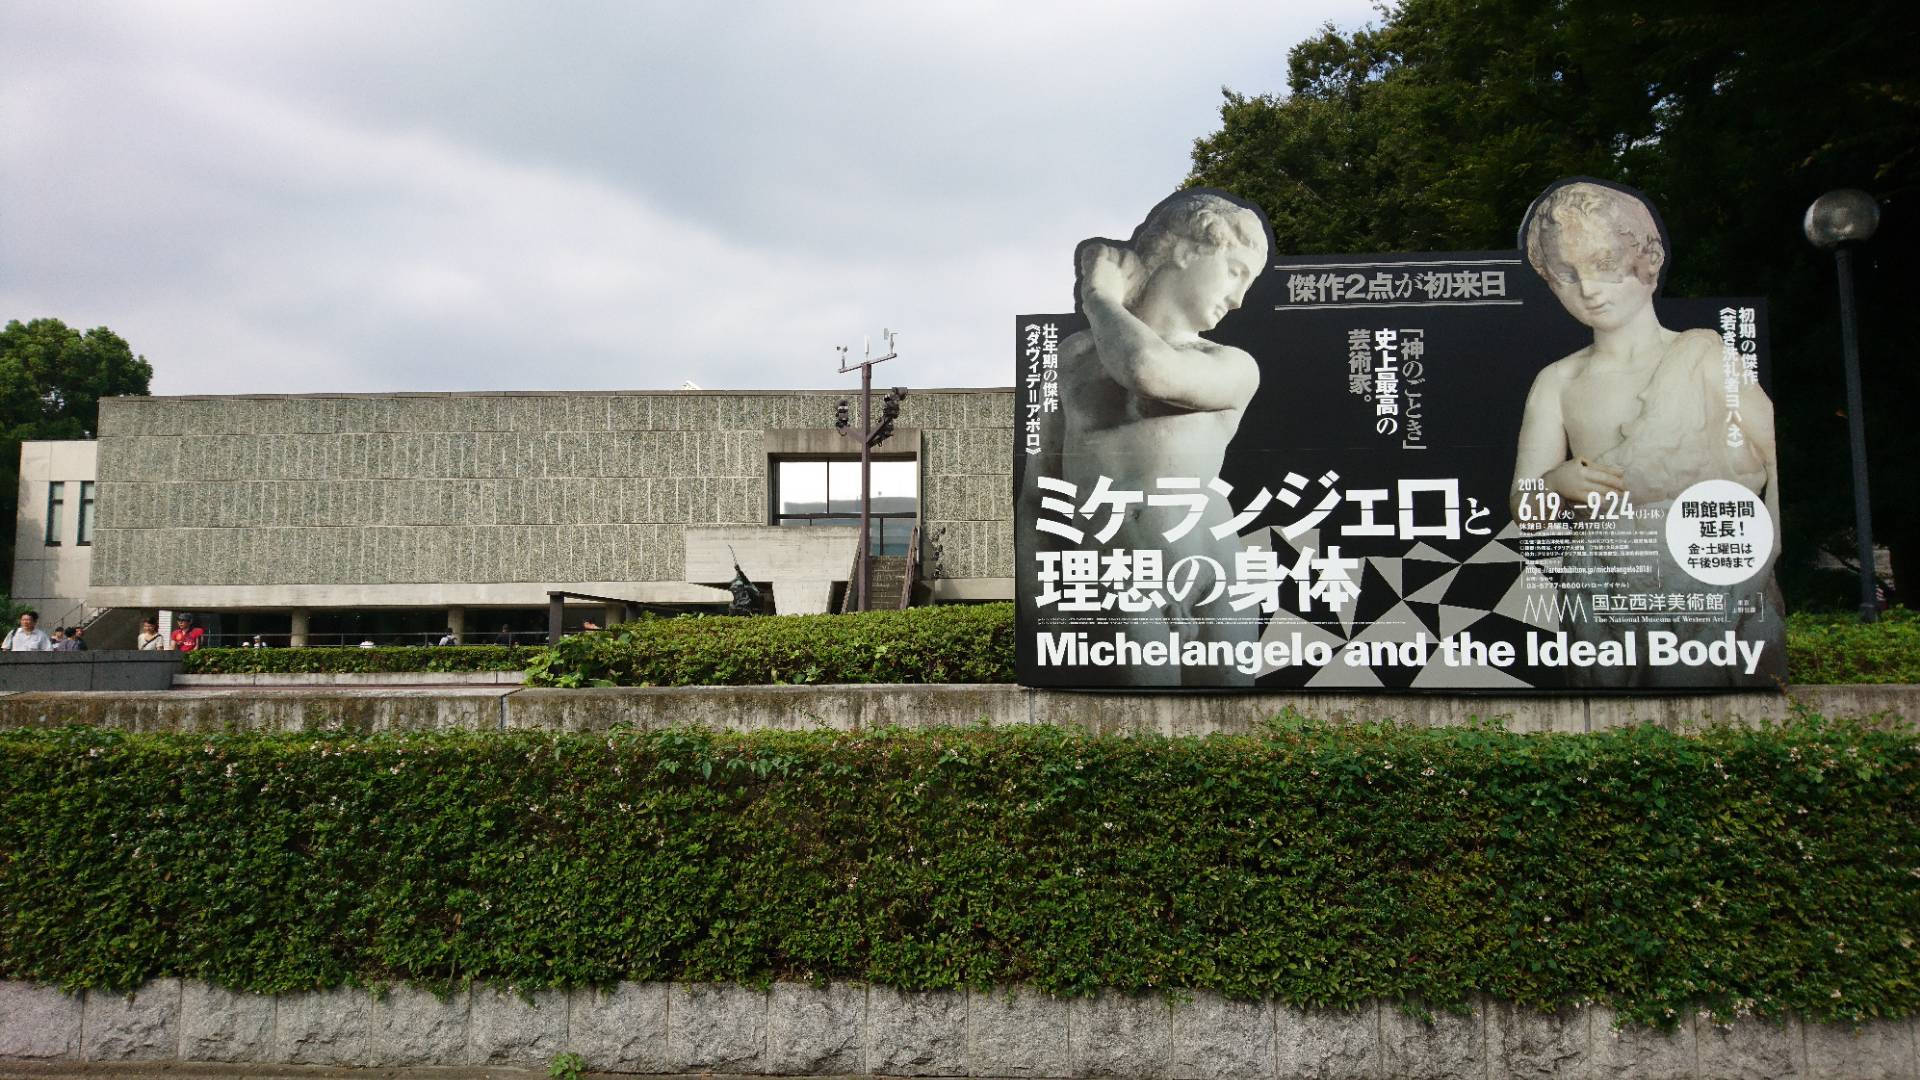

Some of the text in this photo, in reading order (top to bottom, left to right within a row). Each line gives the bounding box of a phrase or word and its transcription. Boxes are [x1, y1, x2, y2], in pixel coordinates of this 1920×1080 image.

[1287, 270, 1506, 302] 傑作2点が初来日
[1738, 307, 1759, 385] 初期の傑作
[1042, 323, 1059, 413] 壮年期の傑作
[1348, 329, 1373, 403] 芸術家。
[1374, 328, 1399, 435] 史上最高の
[1400, 328, 1427, 450] 「神のごとき」
[1518, 478, 1549, 491] 2018.
[1035, 470, 1491, 545] ミケランジェロと
[1681, 501, 1755, 518] 開館時間
[1699, 520, 1745, 538] 延長!
[1687, 557, 1755, 569] 午後9時まで
[1688, 543, 1753, 555] 金・土曜日は
[1034, 546, 1362, 613] 理想の身体
[1592, 593, 1725, 611] 国立西洋美術館
[1593, 615, 1607, 623] The
[1609, 615, 1640, 623] National
[1641, 615, 1671, 623] Museum
[1673, 615, 1681, 623] of
[1682, 615, 1711, 623] Western
[1036, 631, 1766, 675] Michelangelo and the Ideal Body
